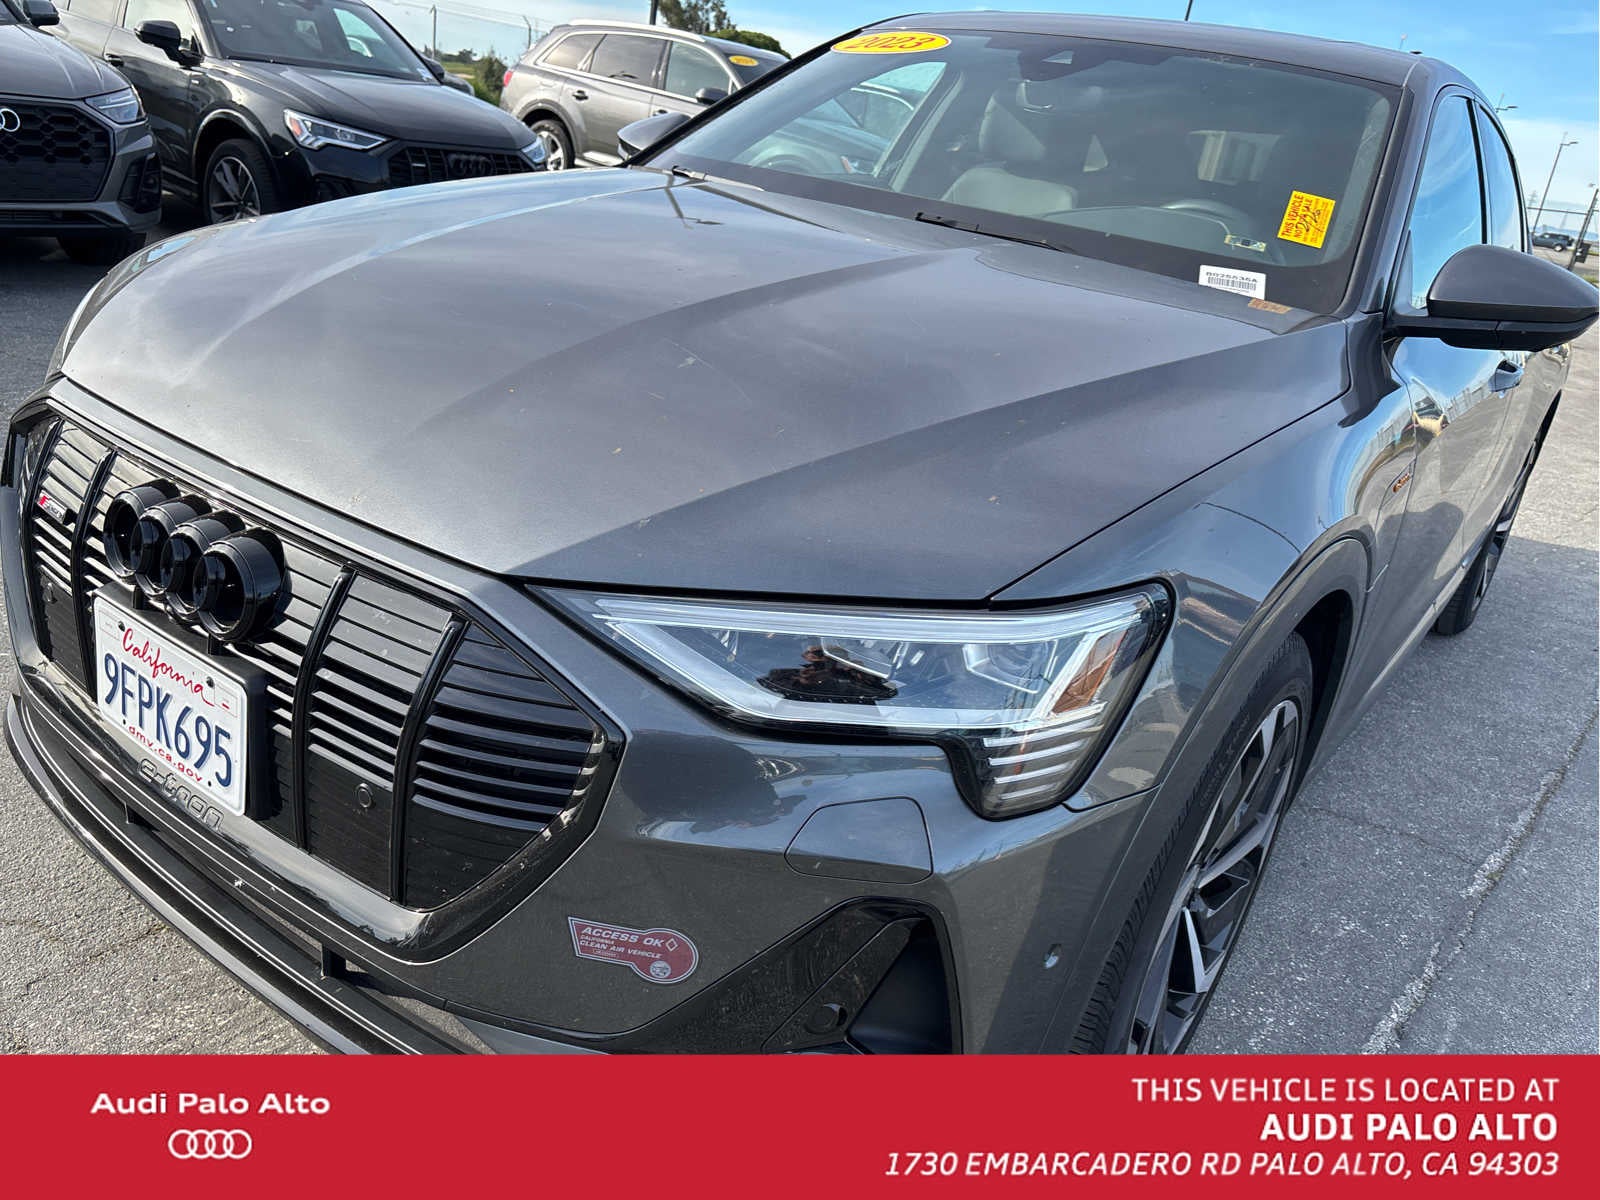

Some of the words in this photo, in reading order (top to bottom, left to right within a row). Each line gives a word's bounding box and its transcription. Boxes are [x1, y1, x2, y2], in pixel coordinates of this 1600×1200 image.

[845, 36, 936, 50] 2023
[1287, 194, 1304, 221] VEHICLE
[1281, 222, 1295, 237] THIS
[122, 628, 216, 708] California
[104, 653, 232, 788] 9FPK695
[128, 725, 203, 783] dmv.ca.gov
[138, 758, 226, 832] e-tron
[579, 940, 608, 950] CLEAN
[610, 945, 625, 953] AIR
[628, 948, 663, 959] VEHICLE
[581, 926, 639, 943] ACCESS
[643, 937, 665, 948] OK
